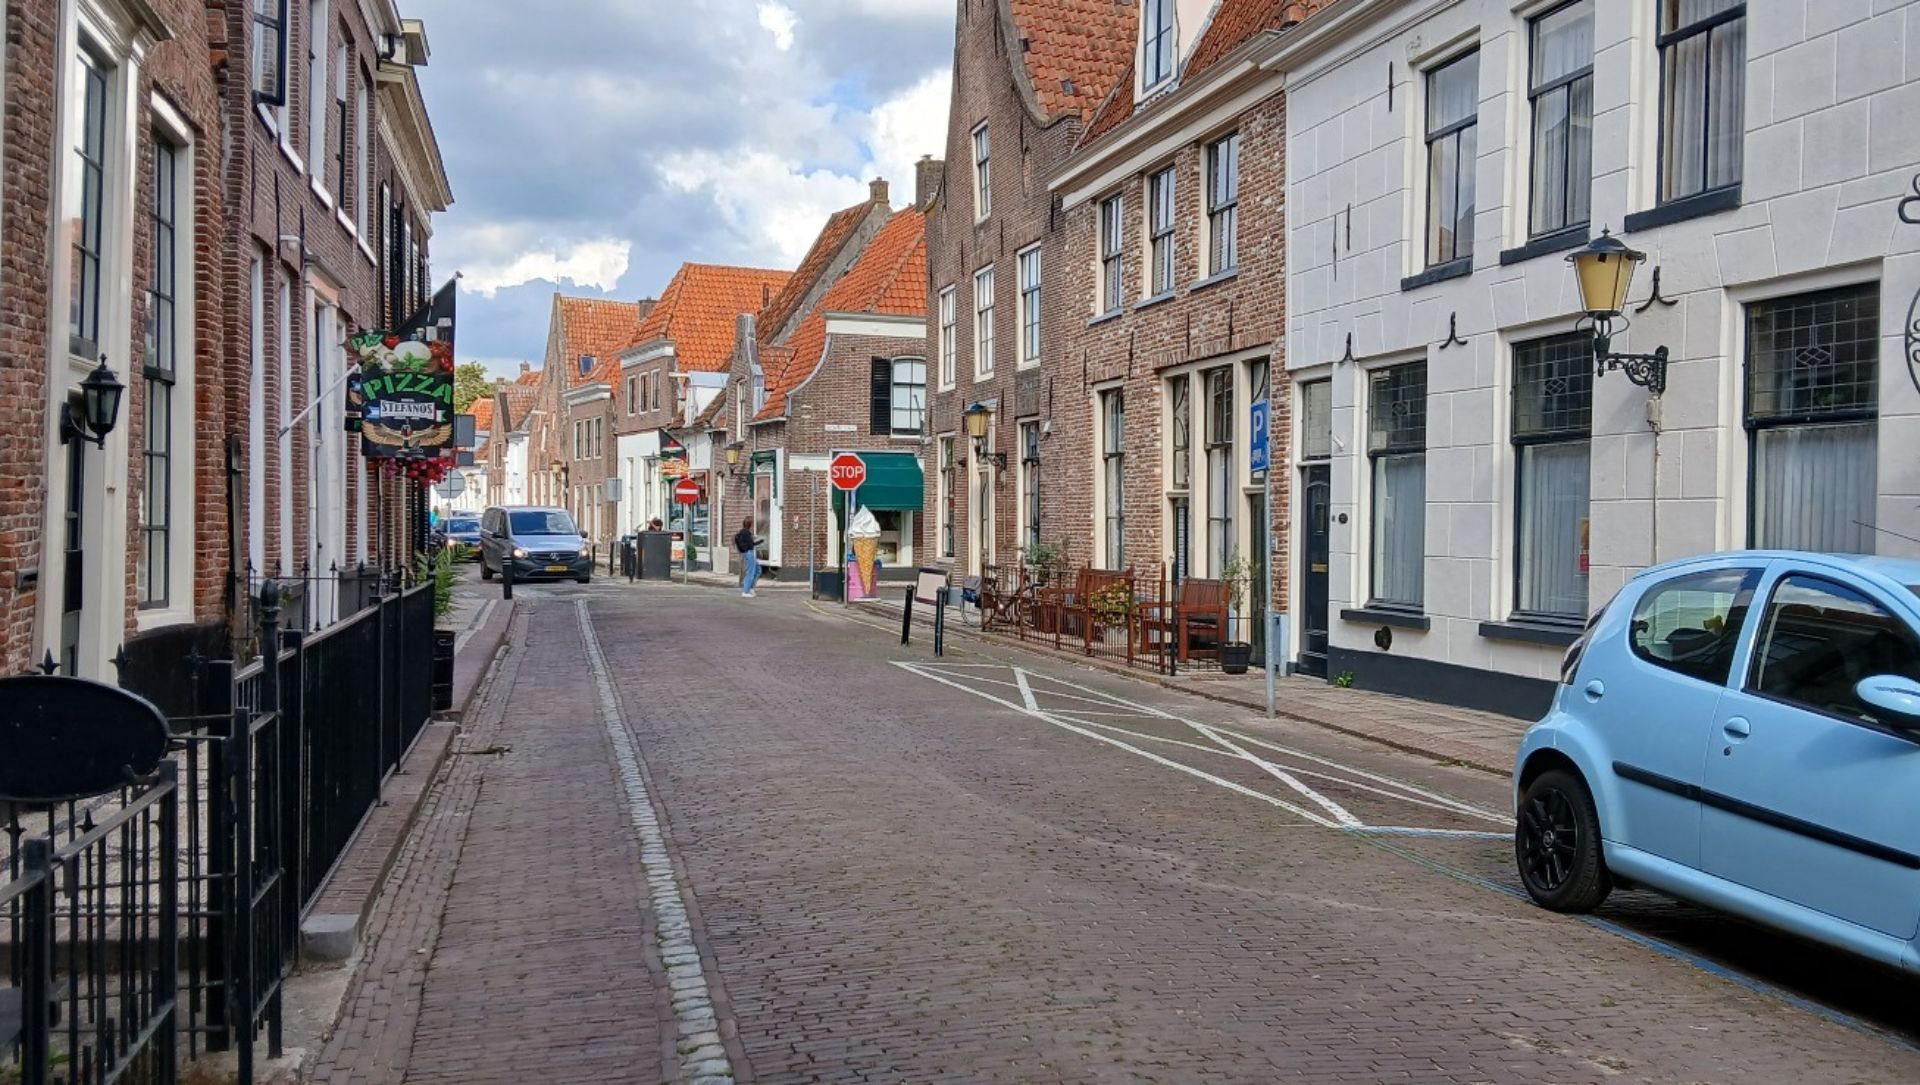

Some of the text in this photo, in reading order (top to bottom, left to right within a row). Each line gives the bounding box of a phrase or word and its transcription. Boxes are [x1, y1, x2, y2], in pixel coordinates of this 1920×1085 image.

[363, 373, 453, 404] PIZZA
[382, 401, 433, 415] STEFANOS
[1253, 410, 1263, 443] P
[832, 465, 864, 479] STOP
